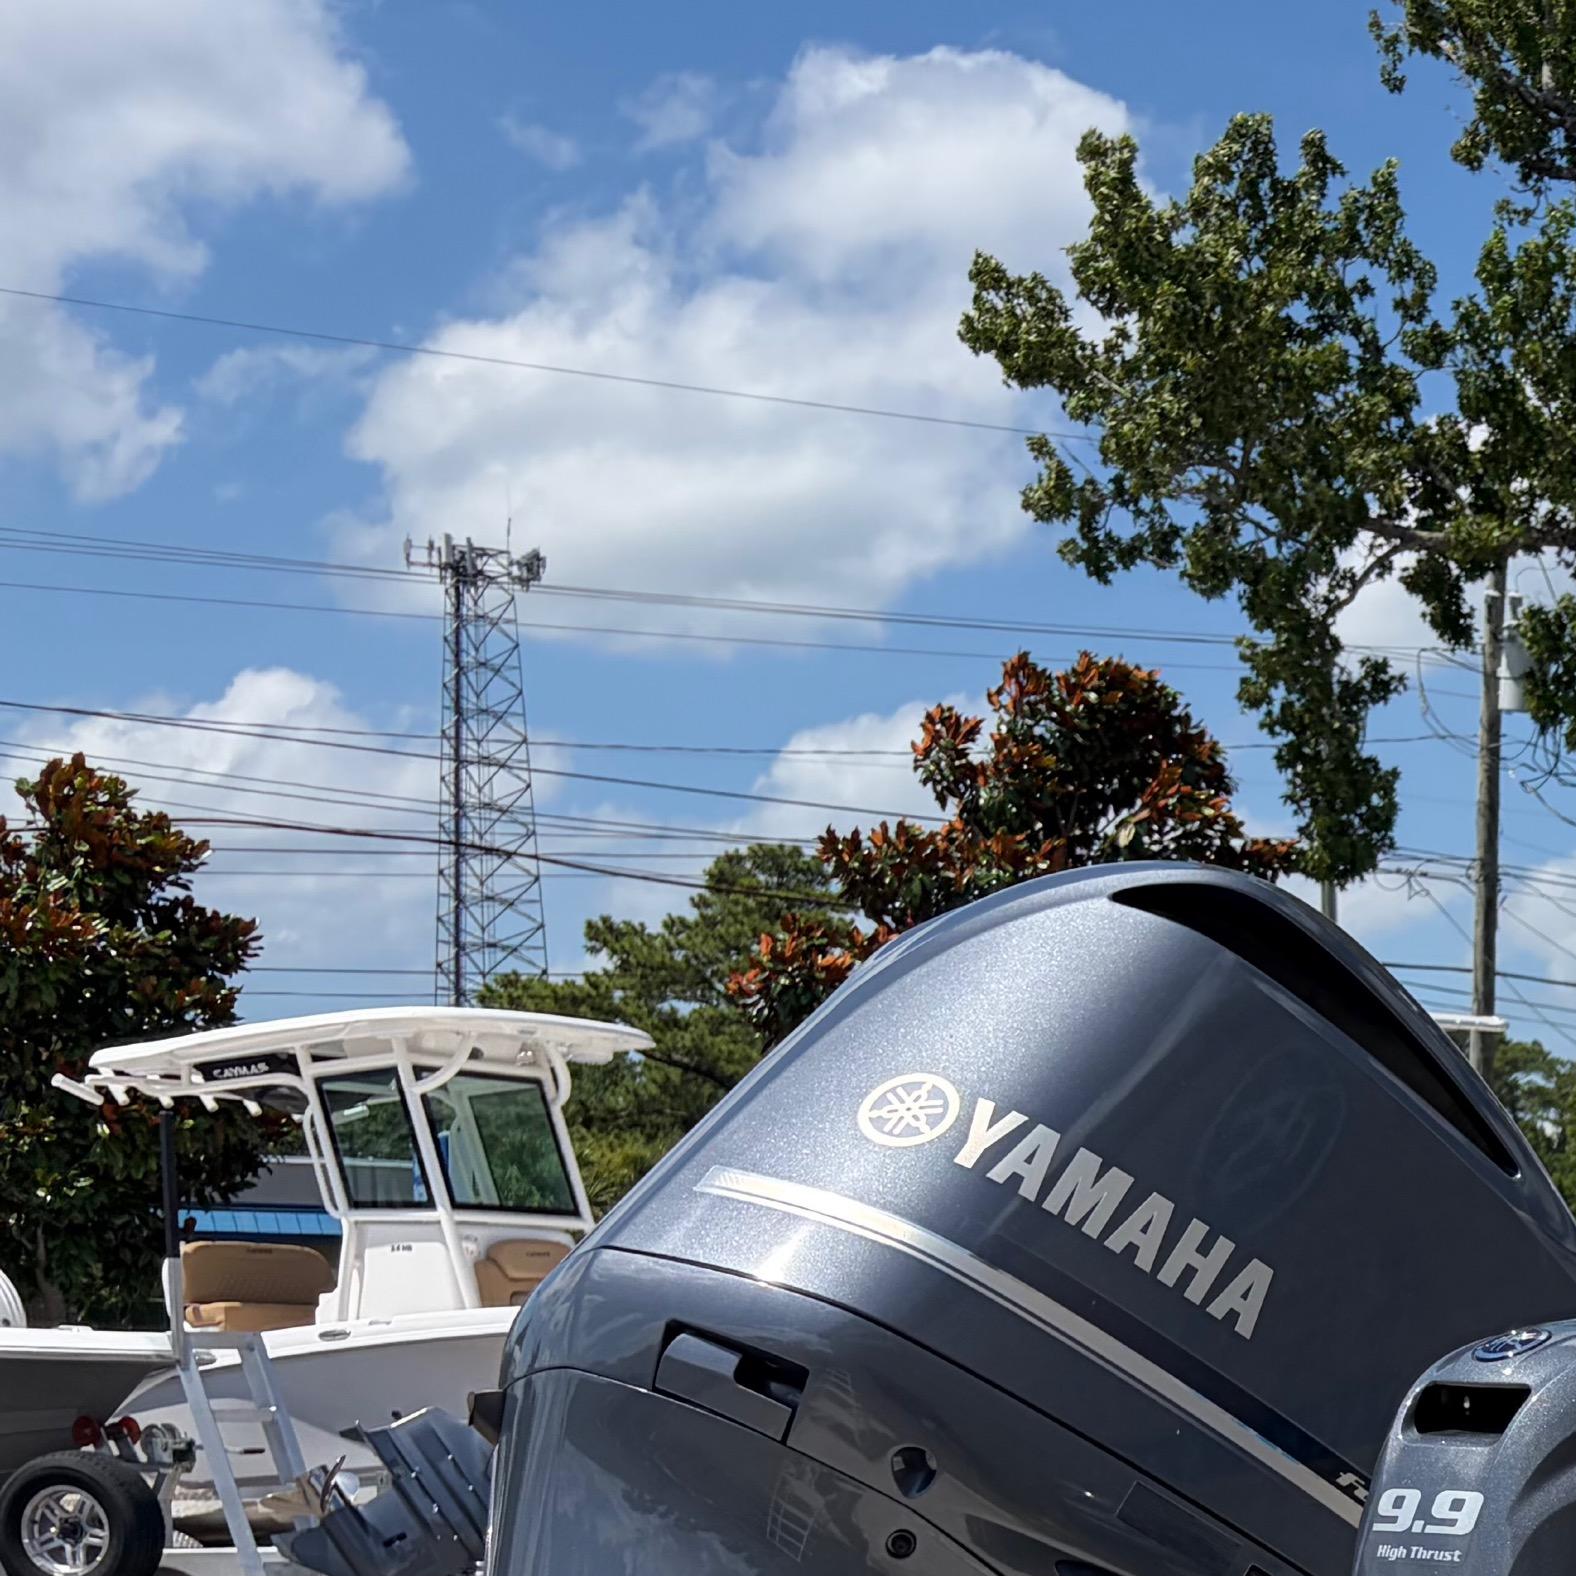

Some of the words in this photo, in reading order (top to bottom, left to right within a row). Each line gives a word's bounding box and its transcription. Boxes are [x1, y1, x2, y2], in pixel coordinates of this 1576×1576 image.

[953, 1097, 1274, 1340] YAMAHA
[1372, 1488, 1484, 1535] 9.9
[1377, 1545, 1407, 1561] High
[1410, 1546, 1463, 1562] Thrust
